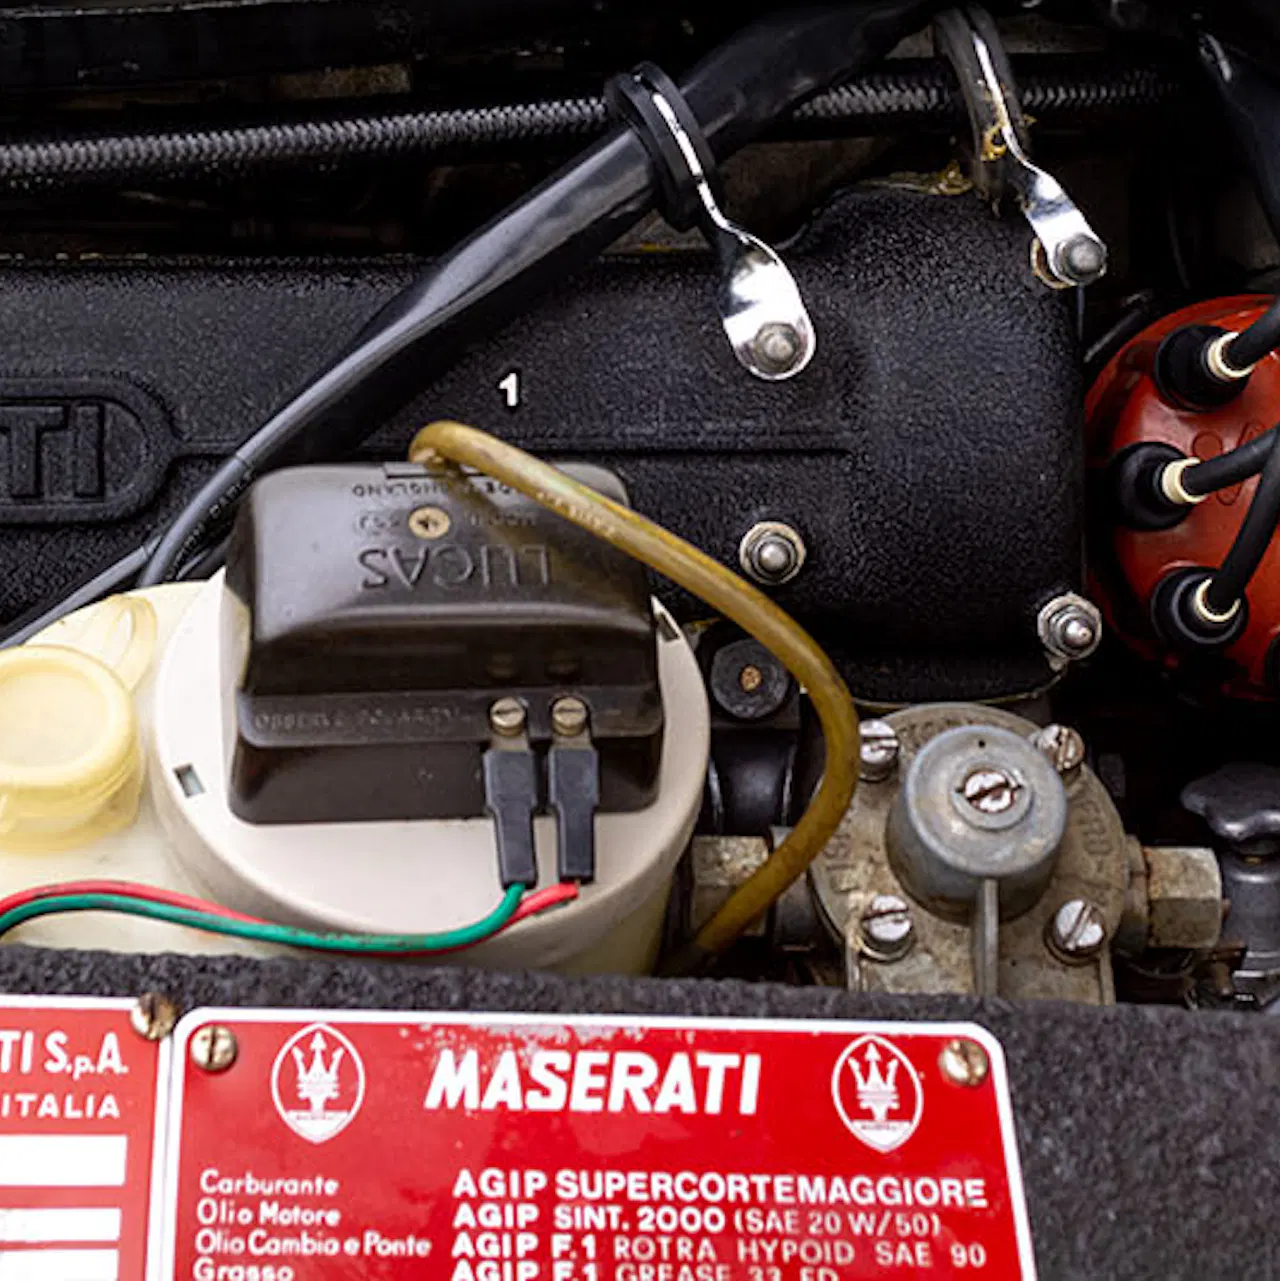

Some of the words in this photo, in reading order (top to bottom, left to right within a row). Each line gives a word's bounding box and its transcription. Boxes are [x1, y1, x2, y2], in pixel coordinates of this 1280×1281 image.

[497, 372, 519, 407] 1
[355, 543, 550, 592] LUCAS
[424, 1048, 762, 1115] MASERATI
[0, 1093, 121, 1118] ITALIA
[199, 1168, 340, 1196] Carburante
[451, 1167, 548, 1199] AGIP
[555, 1169, 989, 1209] SUPERCORTEMAGGIORE
[196, 1196, 254, 1226] Olio
[259, 1199, 342, 1228] Motore
[451, 1202, 540, 1229] AGIP
[553, 1203, 630, 1231] SINT.
[636, 1205, 726, 1234] 2000
[733, 1206, 801, 1235] (SAE
[807, 1209, 842, 1236] 20
[847, 1210, 943, 1238] W/50)
[194, 1227, 245, 1256] Olio
[247, 1228, 340, 1256] Cambio
[343, 1237, 361, 1256] e
[363, 1229, 432, 1257] Ponte
[450, 1230, 539, 1259] AGIP
[550, 1233, 597, 1260] F.1
[612, 1235, 717, 1262] ROTRA
[736, 1238, 856, 1266] HYPOID
[874, 1240, 933, 1268] SAE
[950, 1242, 988, 1269] 90
[192, 1256, 295, 1281] Grasso
[450, 1258, 540, 1281] AGIP
[614, 1263, 731, 1281] GREASE
